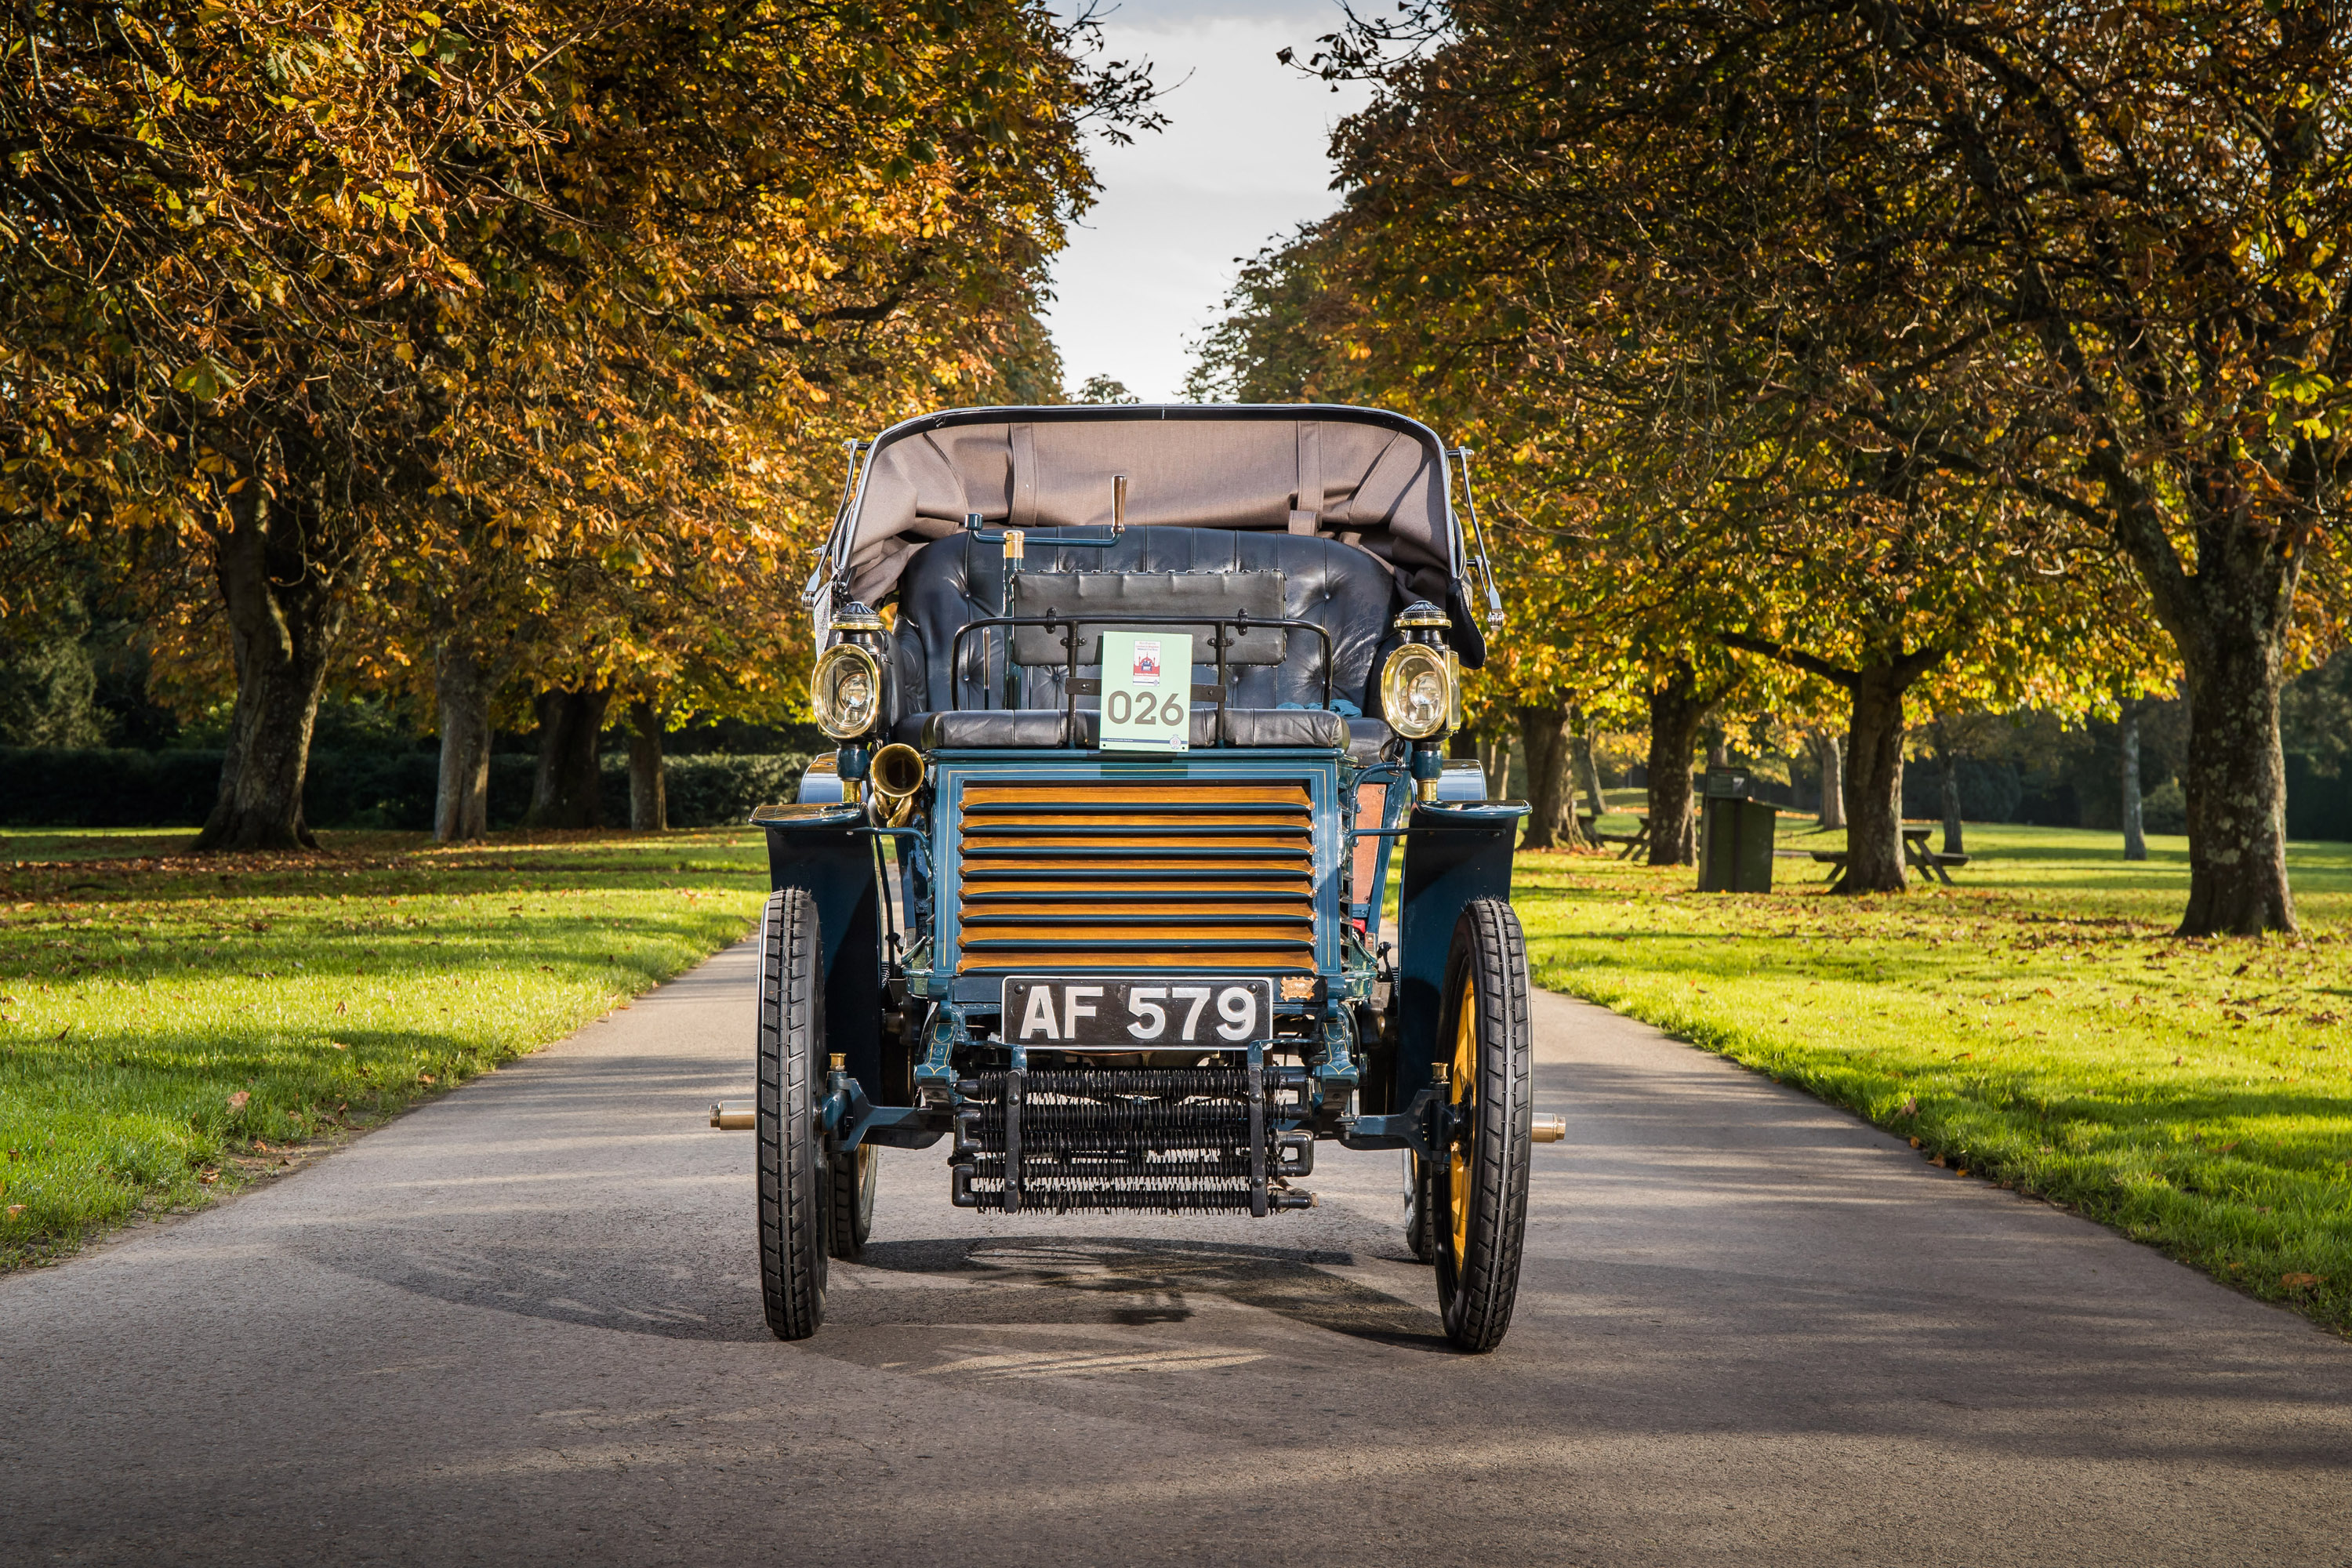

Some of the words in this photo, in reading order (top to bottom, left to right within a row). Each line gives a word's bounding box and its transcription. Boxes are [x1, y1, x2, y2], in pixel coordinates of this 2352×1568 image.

[1108, 690, 1185, 726] 026
[1018, 985, 1105, 1040] AF
[1126, 986, 1258, 1042] 579
